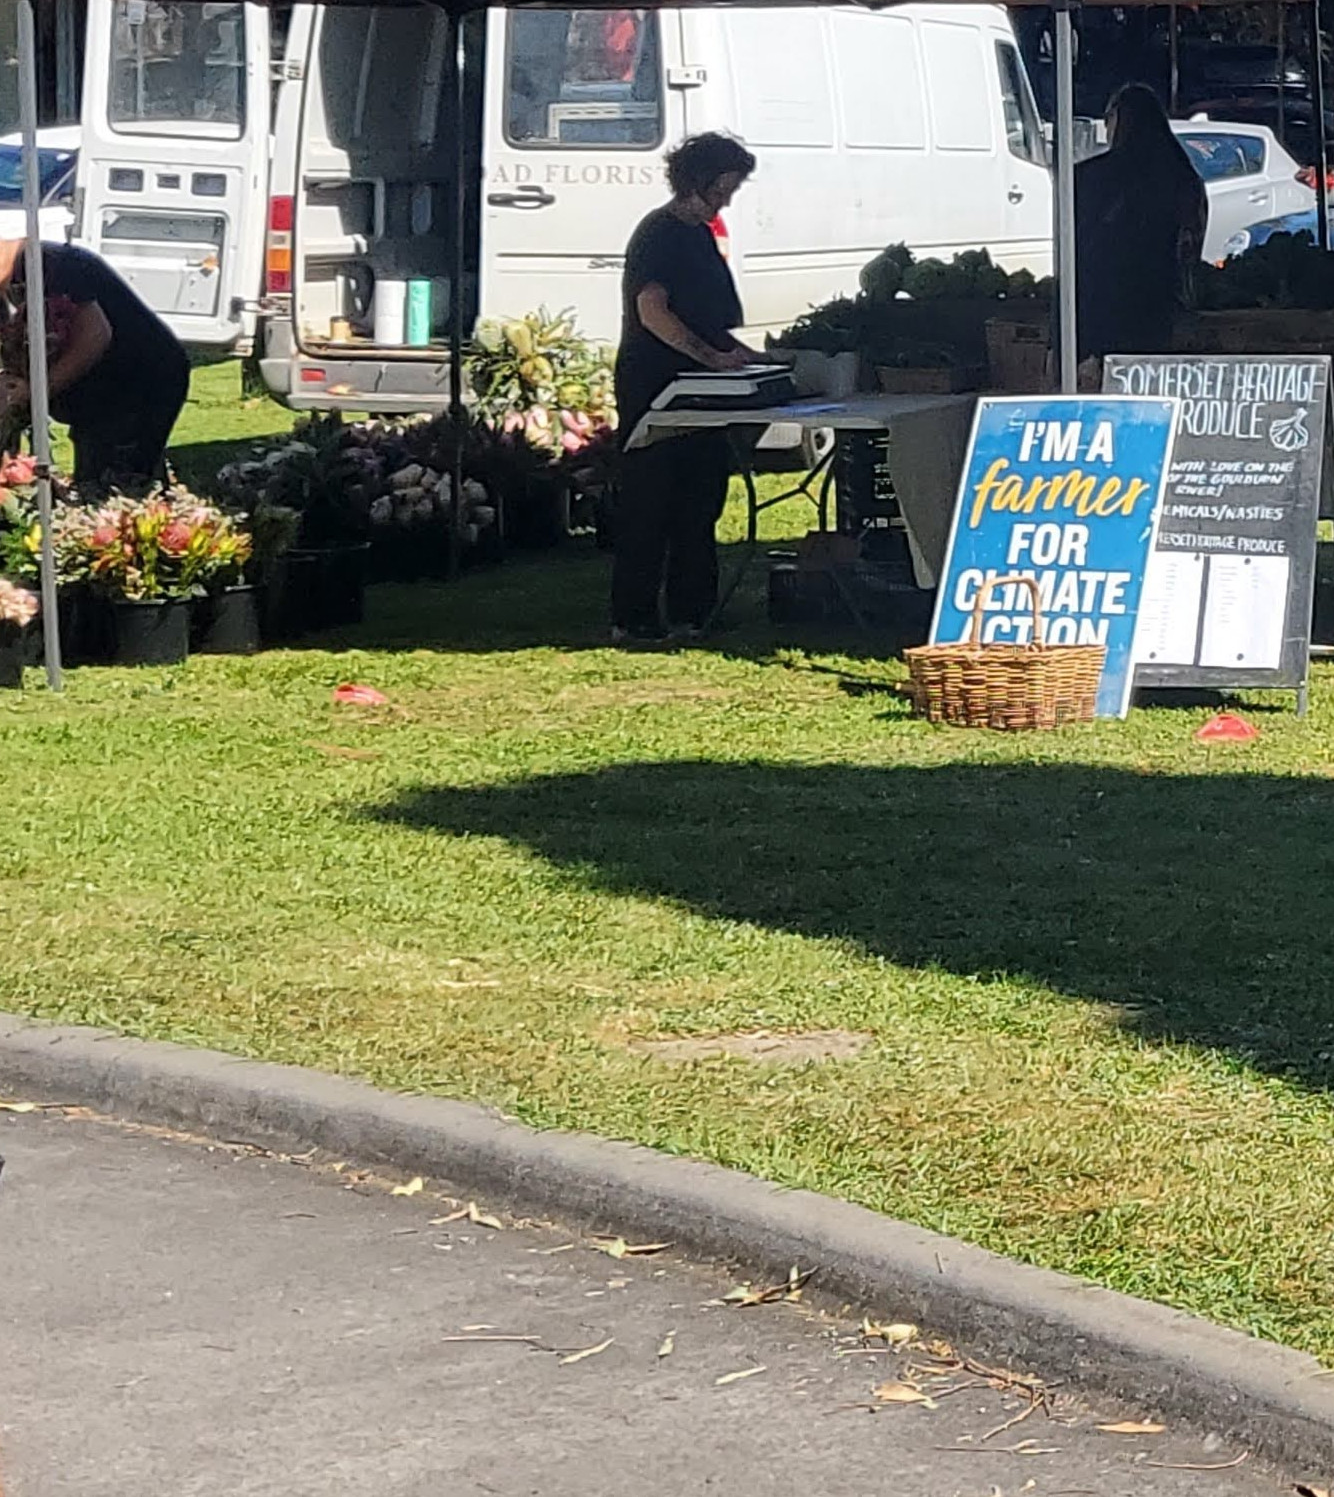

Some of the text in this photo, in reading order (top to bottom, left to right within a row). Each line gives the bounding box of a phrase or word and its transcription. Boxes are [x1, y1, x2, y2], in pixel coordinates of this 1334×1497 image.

[1111, 363, 1325, 403] SOMERSET HERITAGE
[1178, 398, 1266, 439] RODUCE
[1018, 421, 1114, 462] I'M A
[1170, 460, 1206, 472] WITH
[1244, 461, 1266, 473] ON
[1267, 459, 1296, 473] THE
[969, 458, 1151, 529] farmer
[1162, 504, 1284, 521] EMICALS/NASTIES
[1006, 523, 1090, 566] FOR
[954, 568, 1132, 615] CLIMATE
